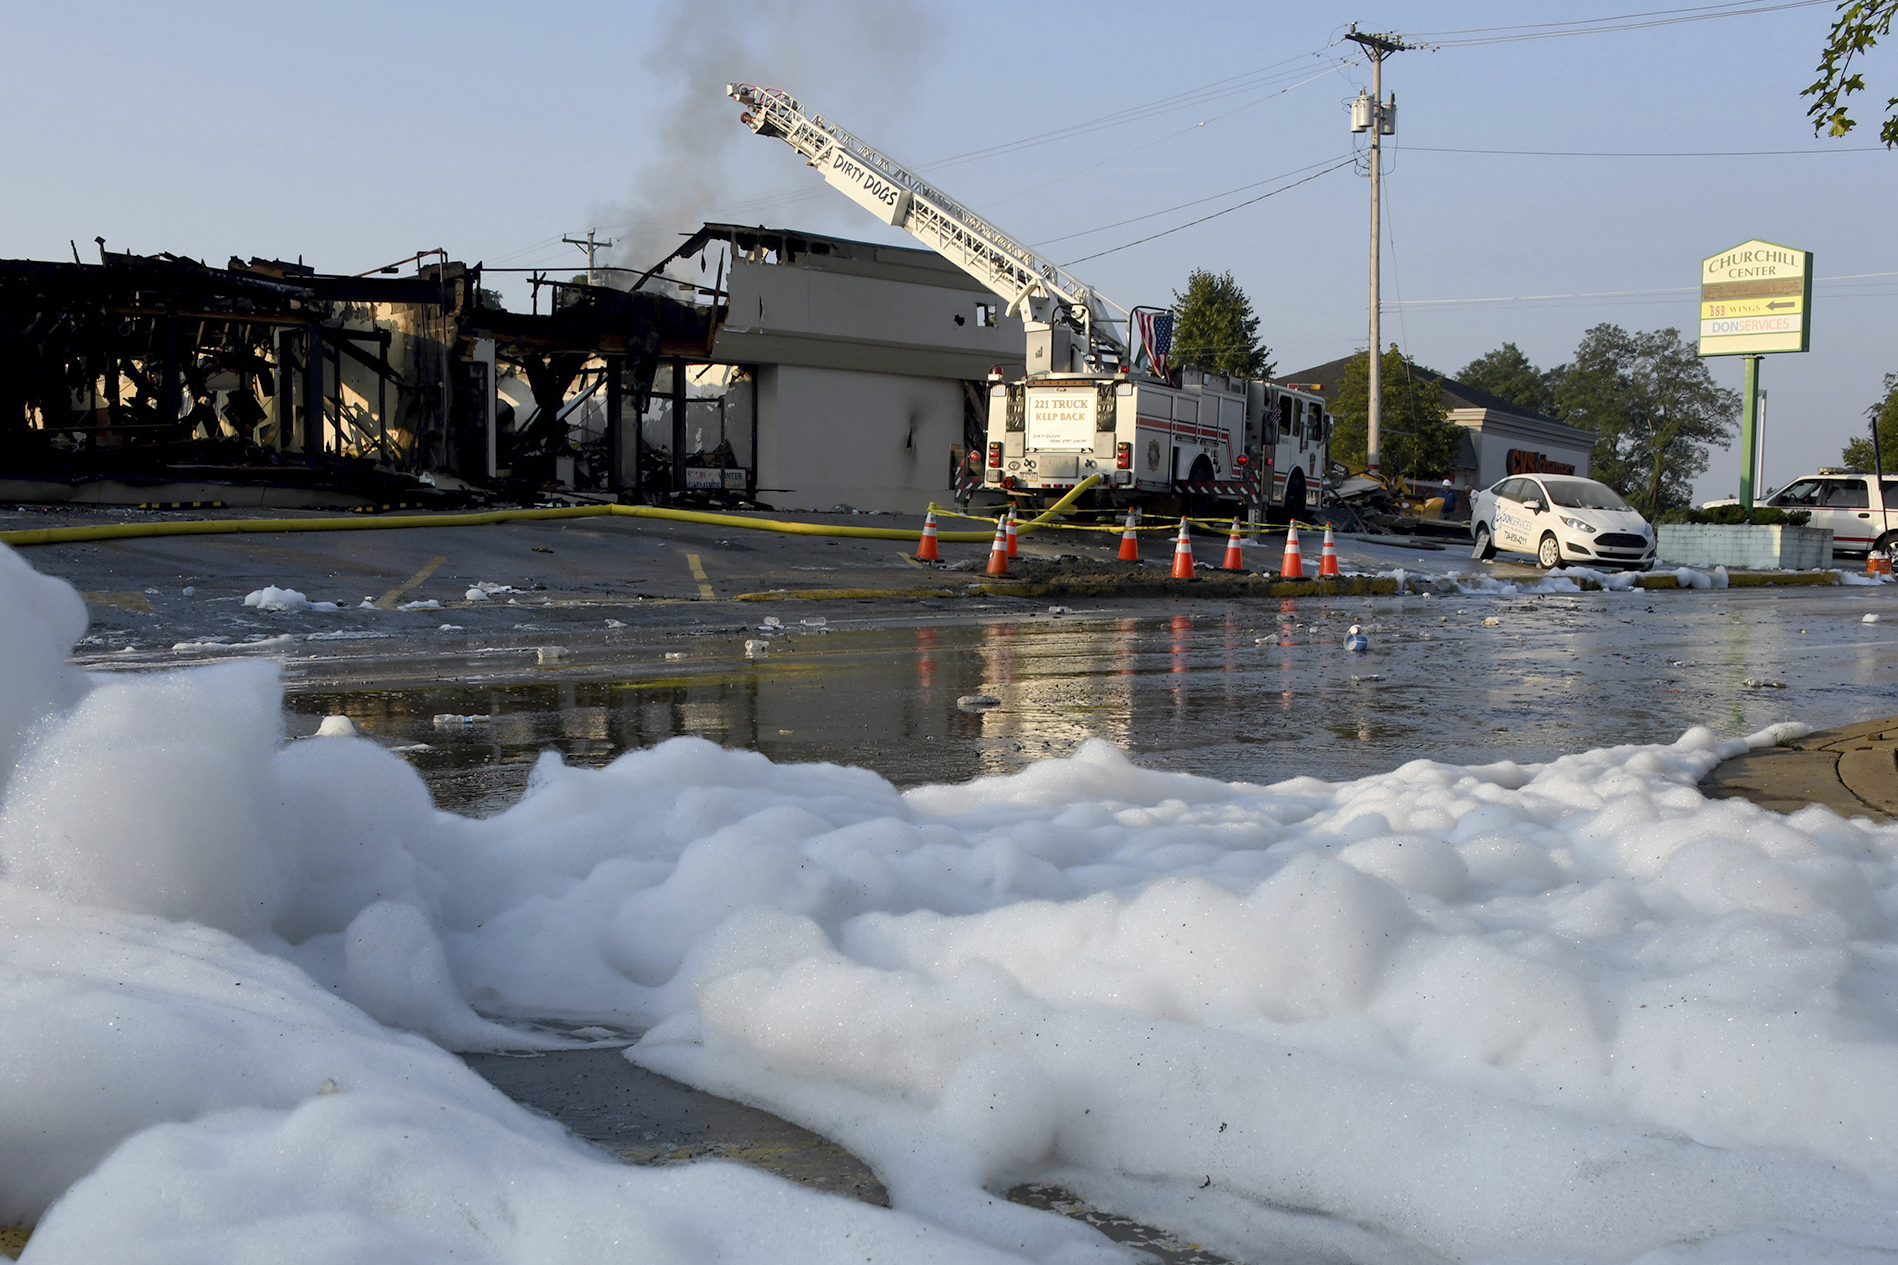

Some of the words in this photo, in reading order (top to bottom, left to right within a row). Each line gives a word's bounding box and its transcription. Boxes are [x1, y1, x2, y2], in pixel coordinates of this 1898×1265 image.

[833, 154, 865, 183] DIRTY
[863, 174, 898, 206] DOGS
[1708, 250, 1798, 273] CHURCHILL
[1728, 266, 1776, 278] CENTER
[1729, 305, 1761, 313] WINGS
[1034, 400, 1049, 409] 221
[1052, 400, 1088, 409] TRUCK
[1035, 413, 1058, 421] KEEP
[1060, 413, 1085, 421] BACK
